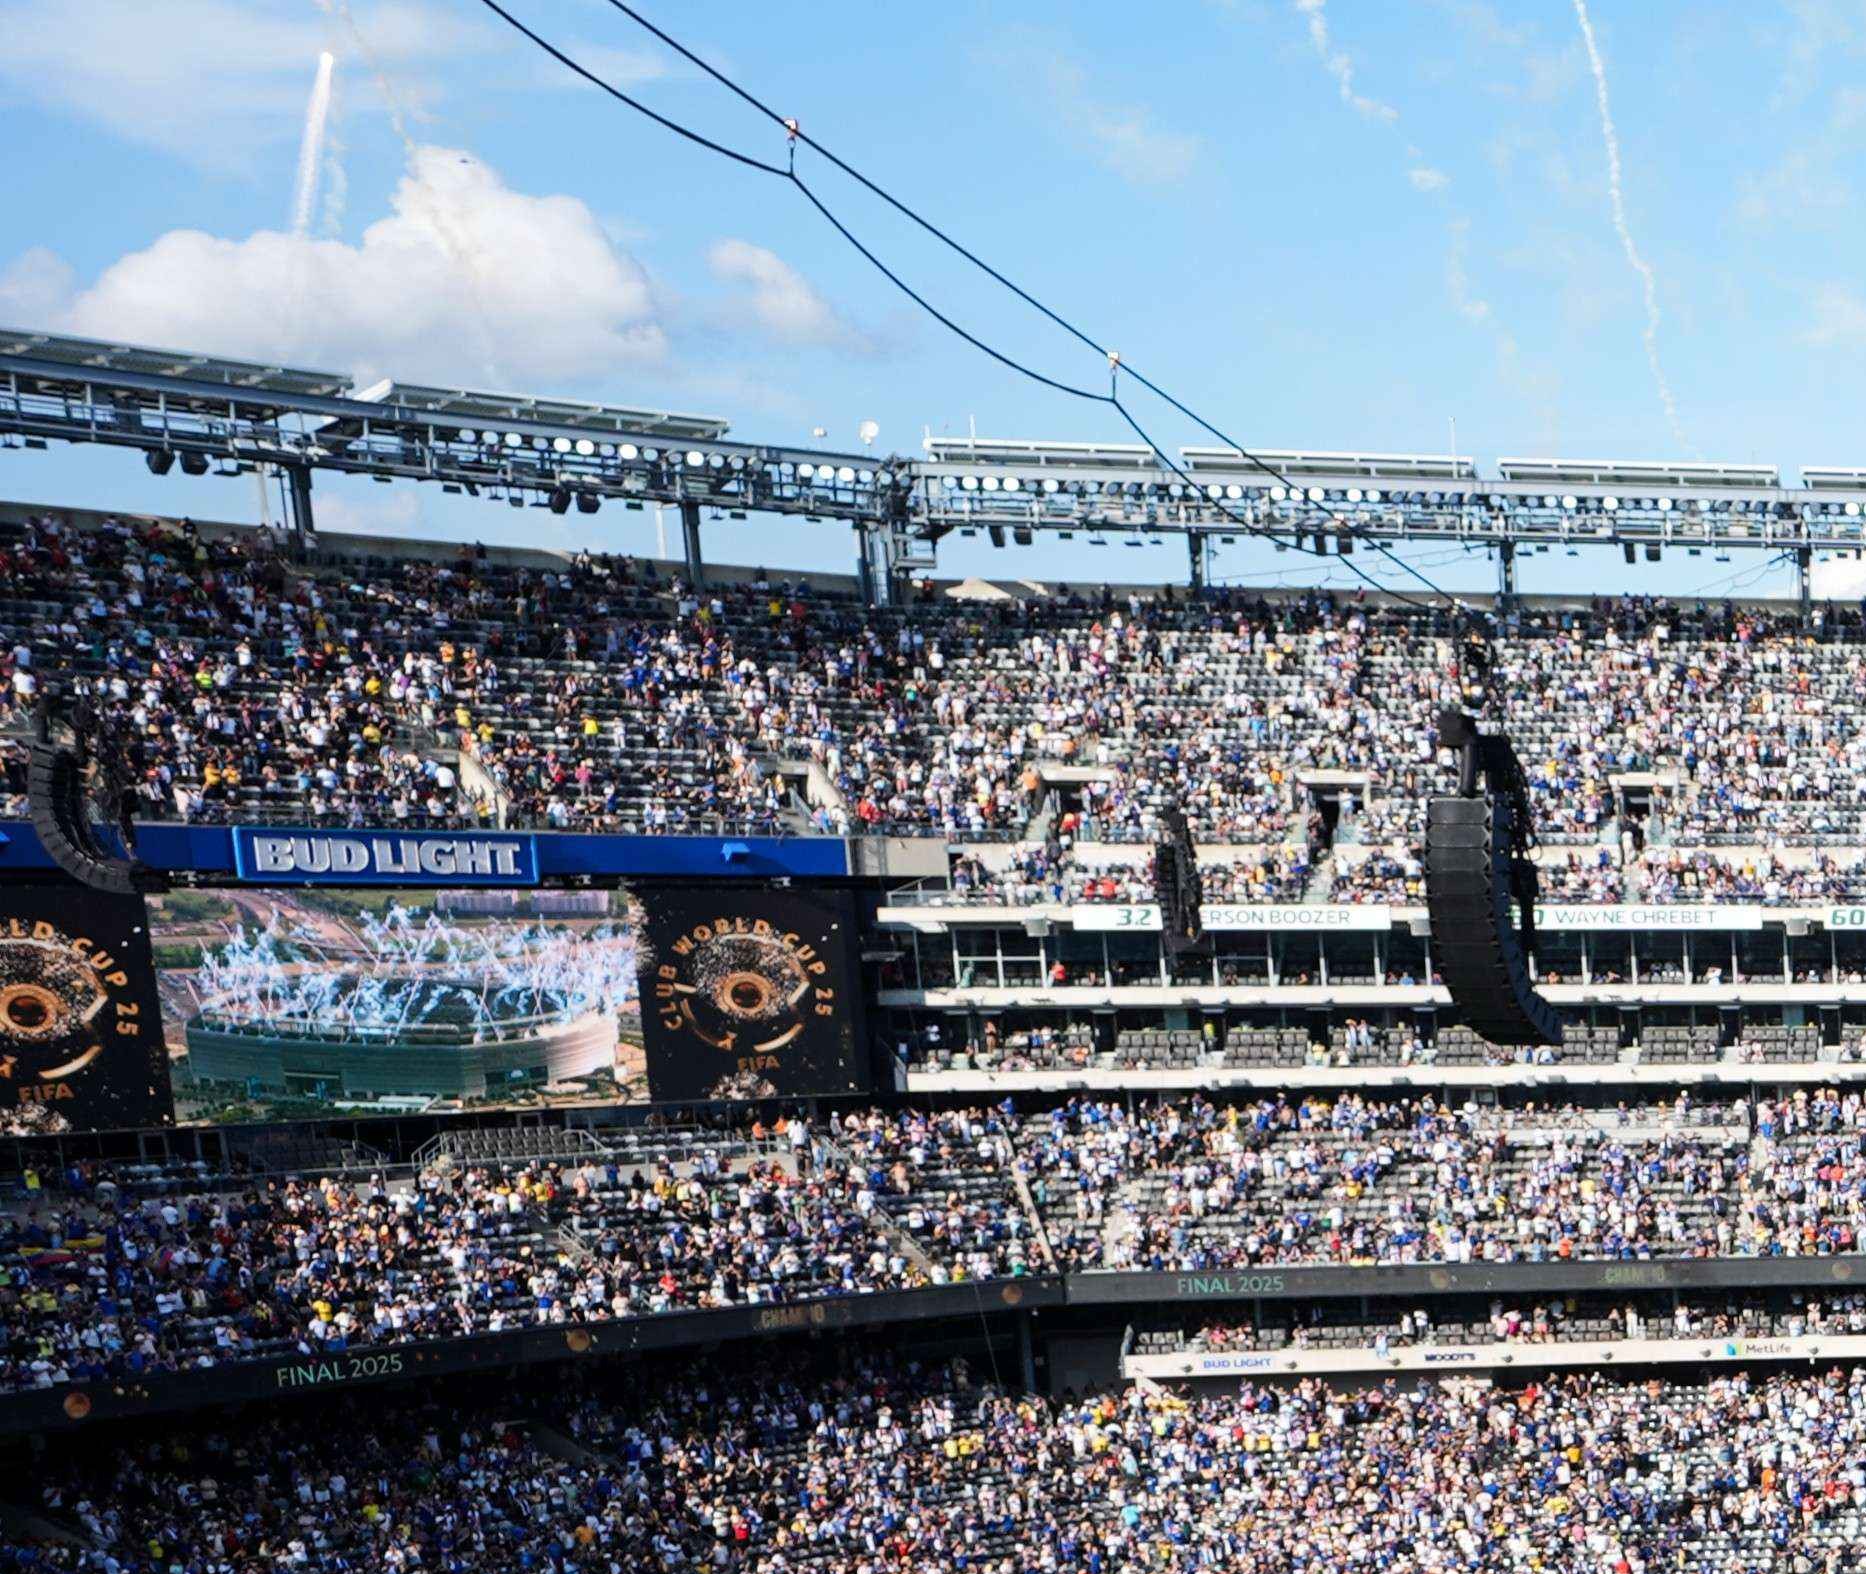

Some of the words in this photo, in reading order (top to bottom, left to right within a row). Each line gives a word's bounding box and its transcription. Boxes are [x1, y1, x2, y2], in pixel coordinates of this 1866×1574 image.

[253, 836, 370, 873] BUD
[372, 838, 522, 875] LIGHT
[1269, 910, 1350, 924] BOOZER
[1554, 910, 1627, 924] WAYNE
[1631, 910, 1718, 924] CHREBET
[1831, 909, 1865, 926] 60
[71, 937, 128, 987] CUP
[18, 1083, 75, 1103] FIFA
[1177, 1277, 1234, 1294] FINAL
[1239, 1275, 1285, 1293] 2025
[1745, 1343, 1792, 1355] MetLife
[276, 1363, 346, 1389] FINAL
[350, 1354, 404, 1379] 2025
